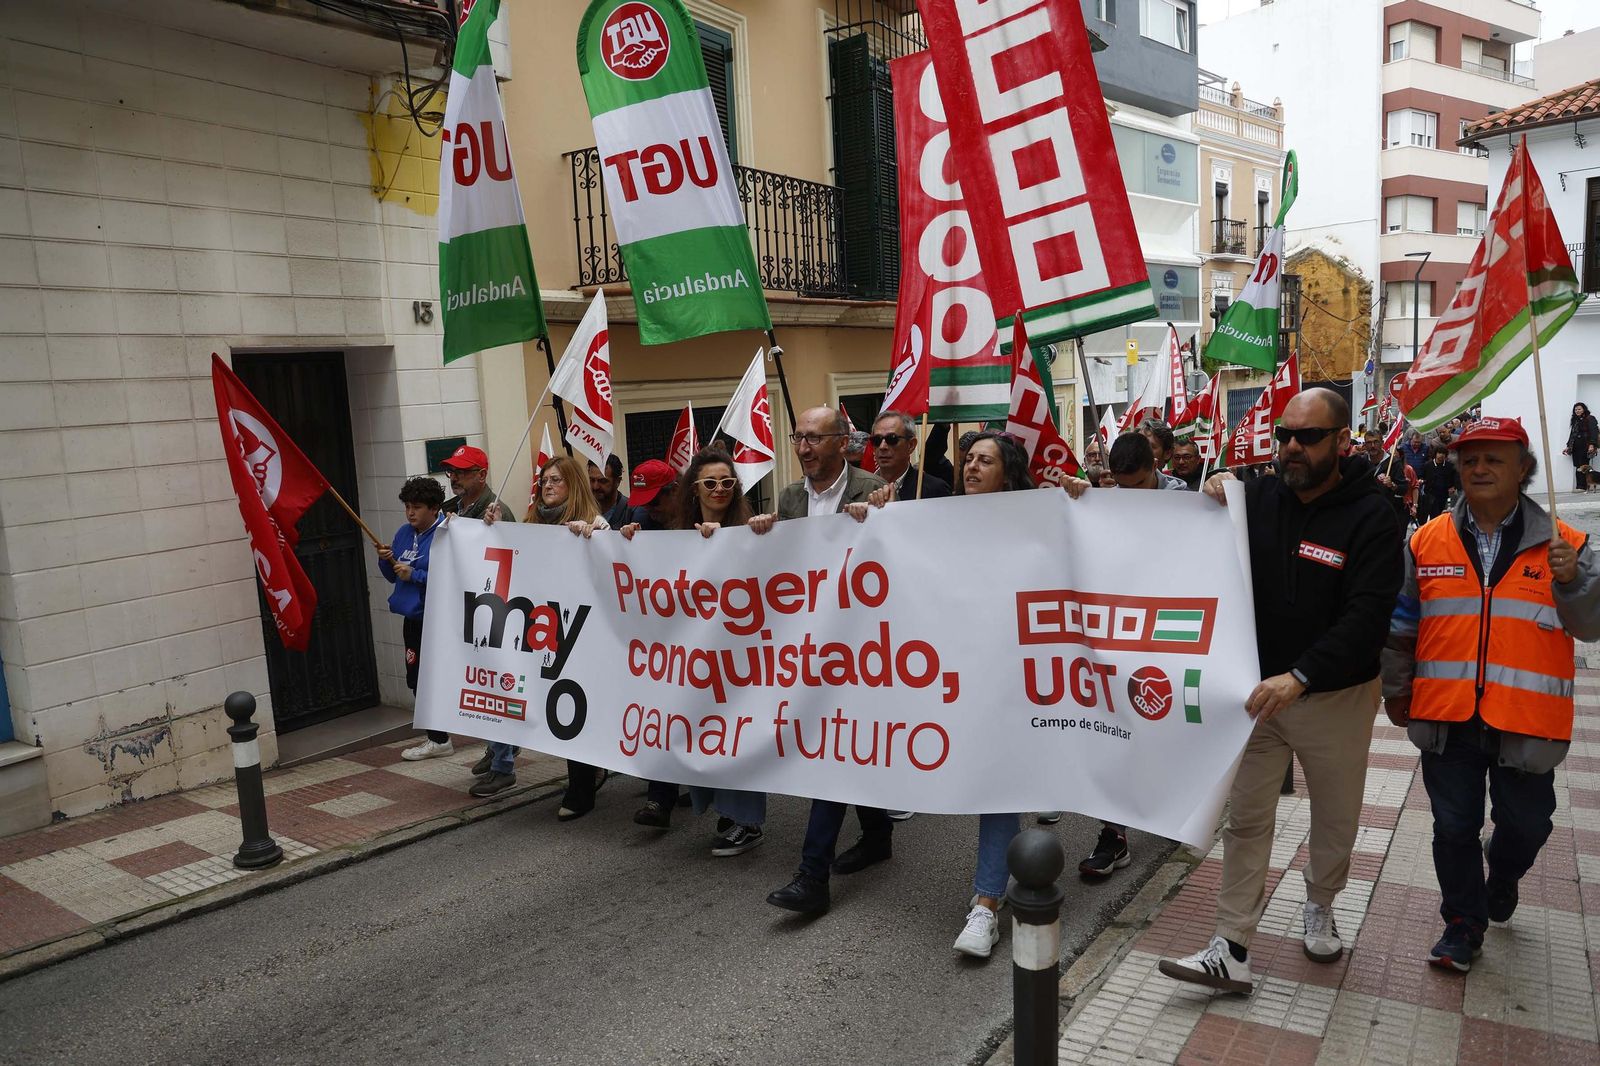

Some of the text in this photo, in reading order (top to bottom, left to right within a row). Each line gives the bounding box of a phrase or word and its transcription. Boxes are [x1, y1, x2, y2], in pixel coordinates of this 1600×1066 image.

[413, 301, 434, 325] 13
[1234, 416, 1250, 460] Cádiz
[1418, 566, 1454, 577] CCOO
[612, 547, 889, 636] Proteger lo
[1027, 600, 1147, 641] CCOO
[465, 665, 498, 689] UGT
[627, 621, 960, 704] conquistado,
[1023, 656, 1117, 714] UGT
[458, 710, 475, 720] Campo
[482, 715, 503, 724] Gibraltar
[463, 692, 505, 713] CCOO
[619, 701, 950, 771] ganar futuro
[1031, 717, 1132, 741] Campo de Gibraltar
